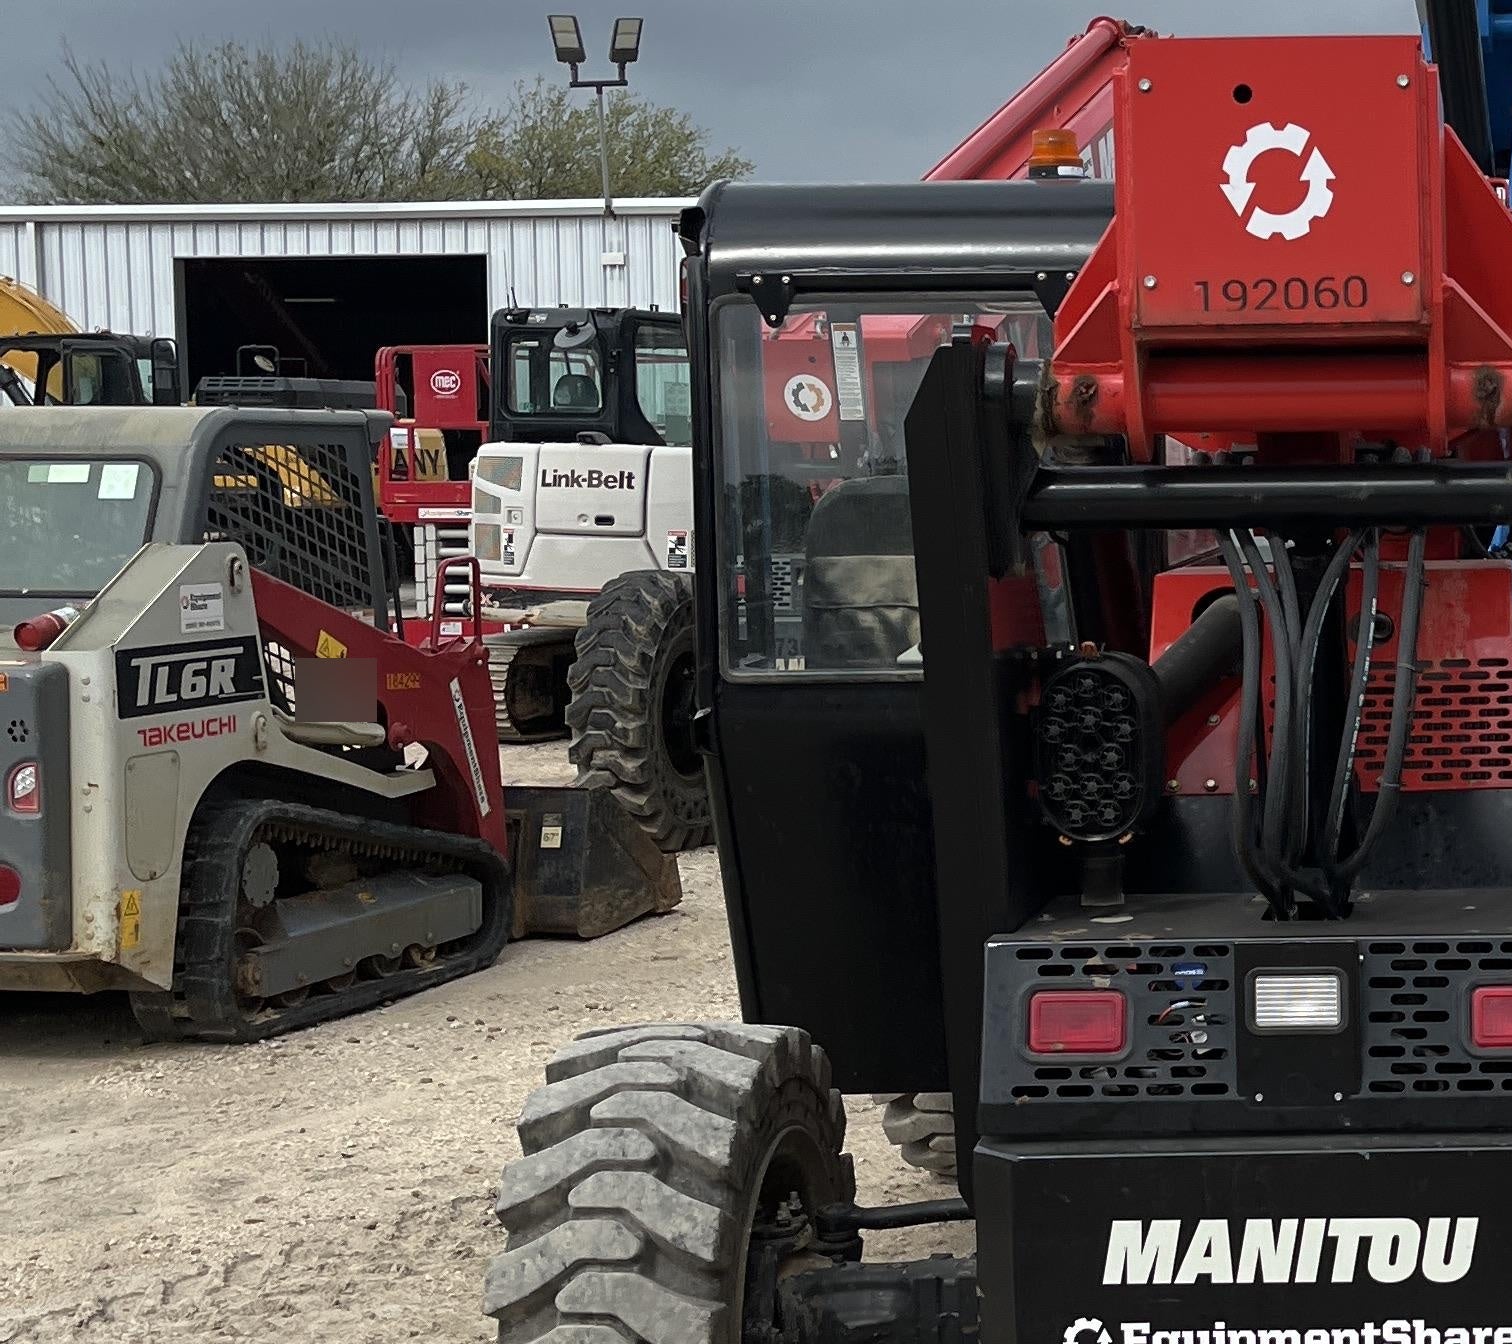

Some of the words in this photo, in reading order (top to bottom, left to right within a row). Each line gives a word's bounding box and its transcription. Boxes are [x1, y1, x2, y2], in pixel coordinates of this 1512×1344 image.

[1193, 274, 1369, 313] 192060
[540, 468, 636, 491] Link-Belt
[131, 646, 244, 707] TL6R
[137, 714, 237, 747] TAKEUCHI
[1102, 1216, 1480, 1286] MANITOU
